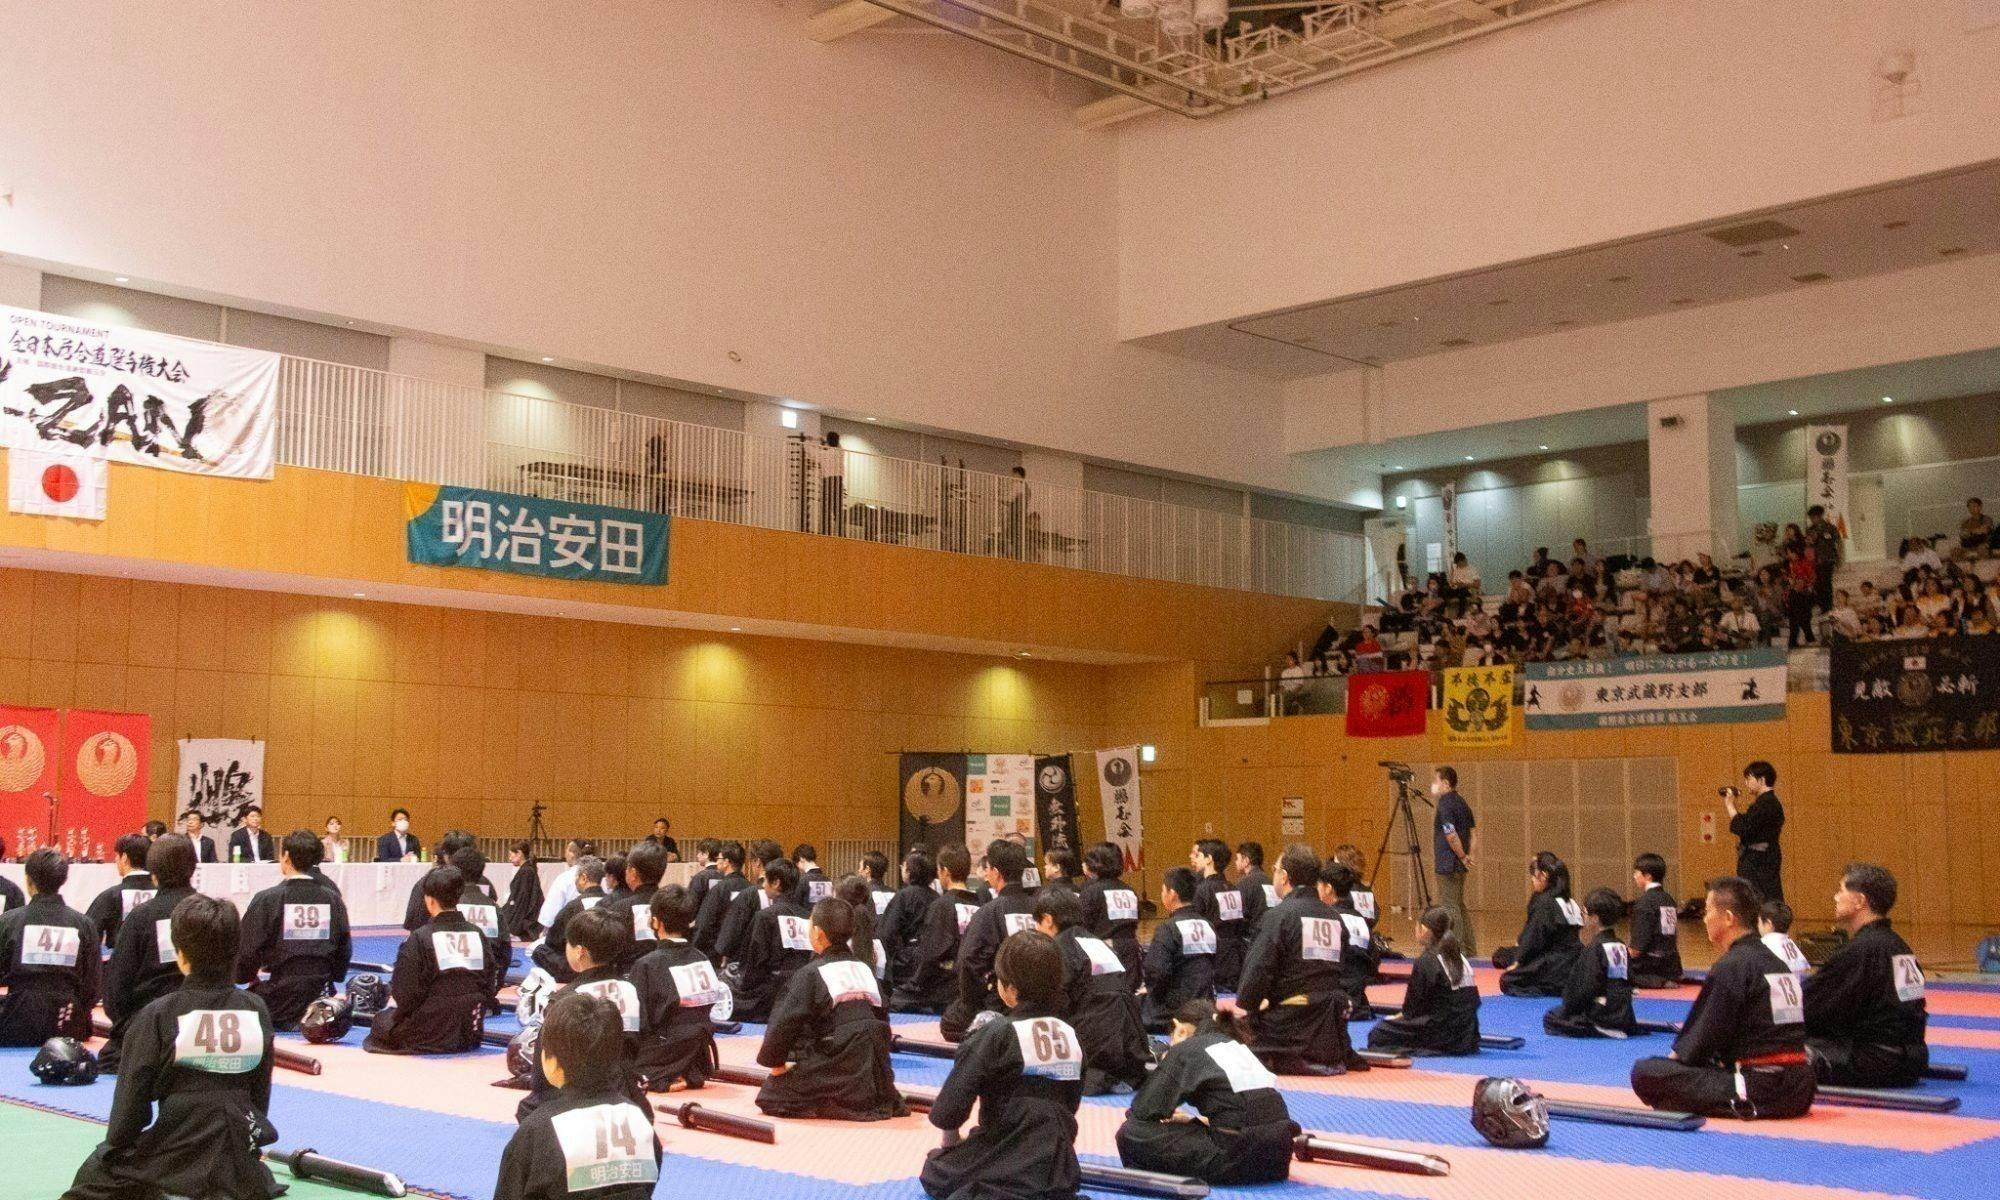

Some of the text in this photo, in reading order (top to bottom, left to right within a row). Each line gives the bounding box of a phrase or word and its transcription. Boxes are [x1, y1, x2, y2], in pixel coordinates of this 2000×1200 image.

[10, 314, 110, 338] OPEN TOURNAMENT
[442, 500, 643, 574] 明治安田
[1595, 681, 1708, 703] 東京武蔵野支部
[1223, 893, 1238, 910] 10
[294, 906, 320, 929] 39
[469, 905, 488, 927] 44
[37, 928, 65, 952] 47
[1312, 920, 1332, 947] 49
[1778, 976, 1798, 1006] 13
[195, 1013, 241, 1053] 48
[1032, 1020, 1071, 1062] 65
[591, 1162, 641, 1182] 明治安田
